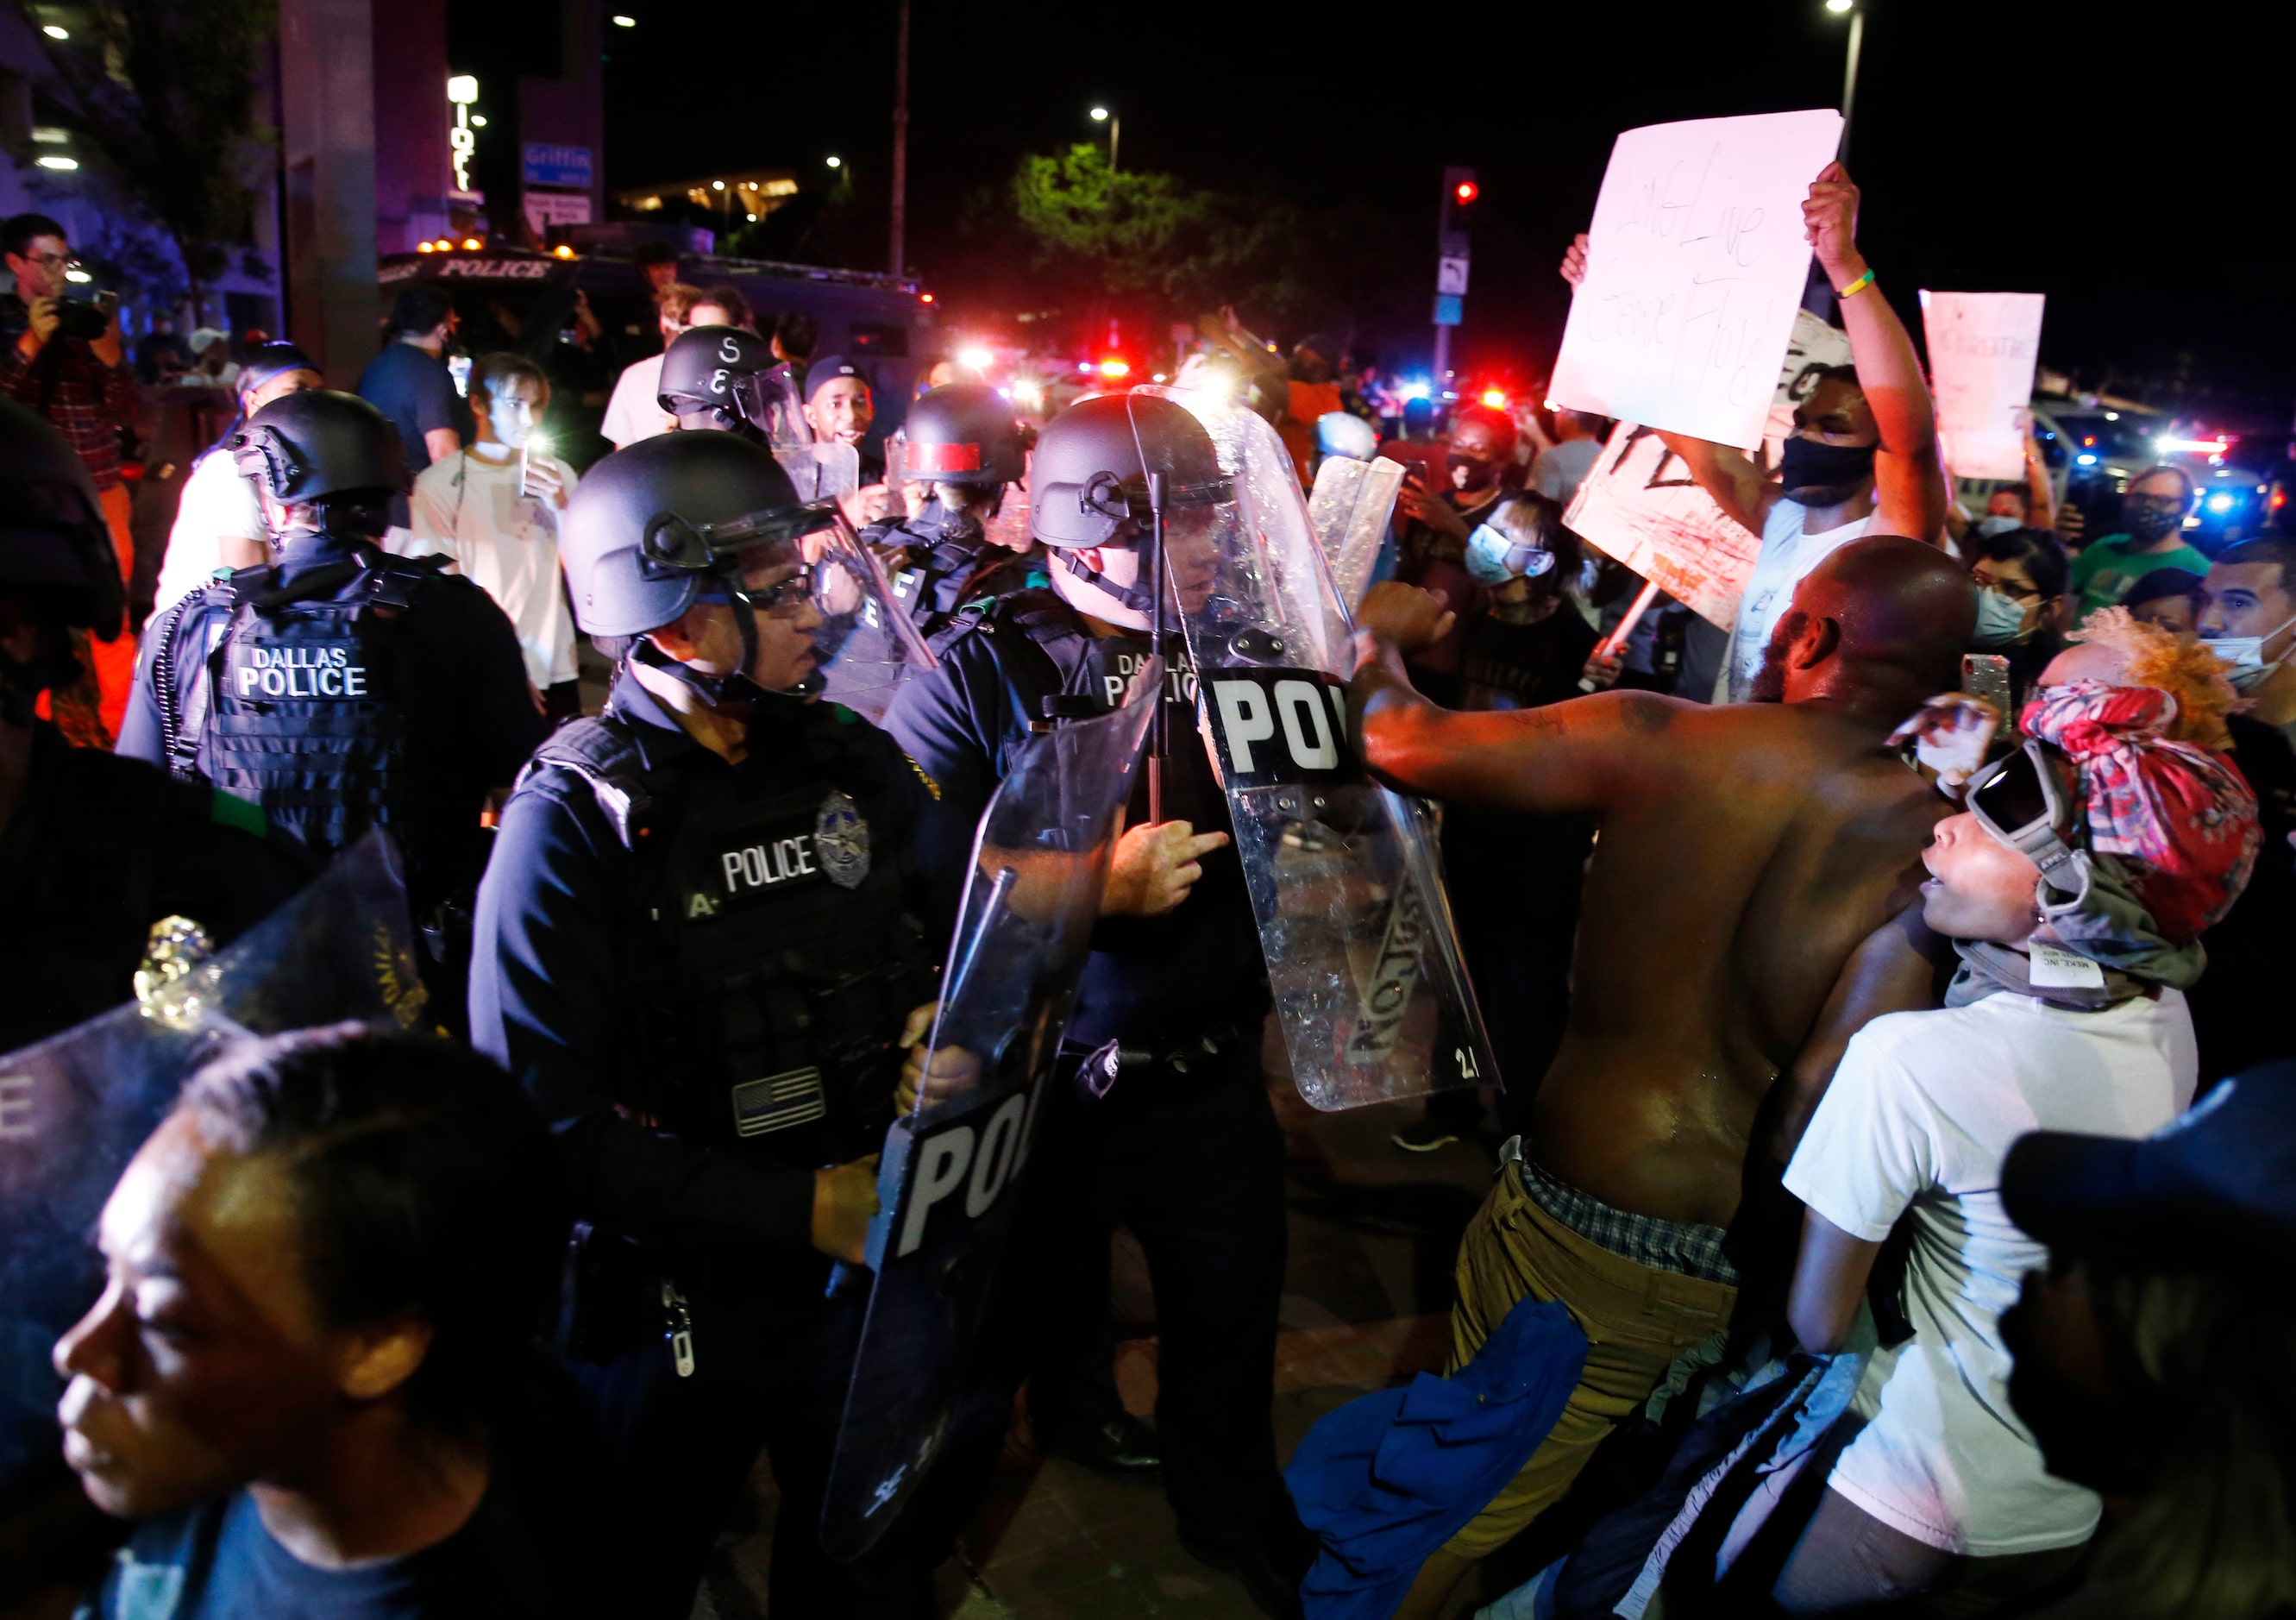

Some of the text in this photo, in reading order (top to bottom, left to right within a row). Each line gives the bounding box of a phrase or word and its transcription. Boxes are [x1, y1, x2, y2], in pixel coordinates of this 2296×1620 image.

[437, 259, 552, 278] POLICE
[251, 647, 347, 669] DALLAS
[237, 666, 367, 696] POLICE
[722, 835, 816, 892] POLICE
